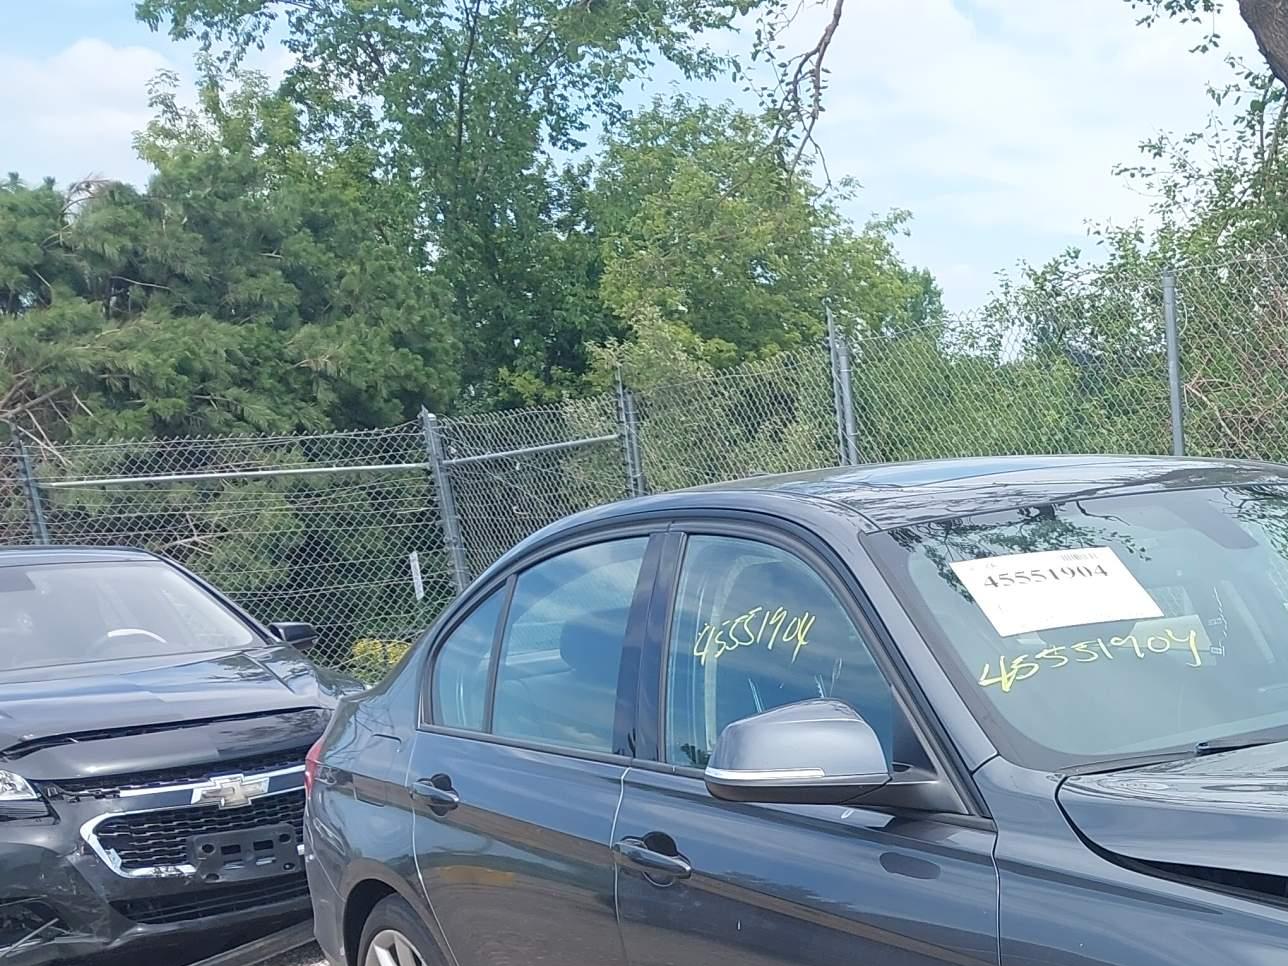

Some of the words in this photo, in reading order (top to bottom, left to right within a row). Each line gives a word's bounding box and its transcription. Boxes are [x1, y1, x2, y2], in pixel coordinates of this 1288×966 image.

[983, 563, 1109, 588] 45551904
[693, 605, 817, 667] 45551904
[978, 628, 1203, 693] 45551904
